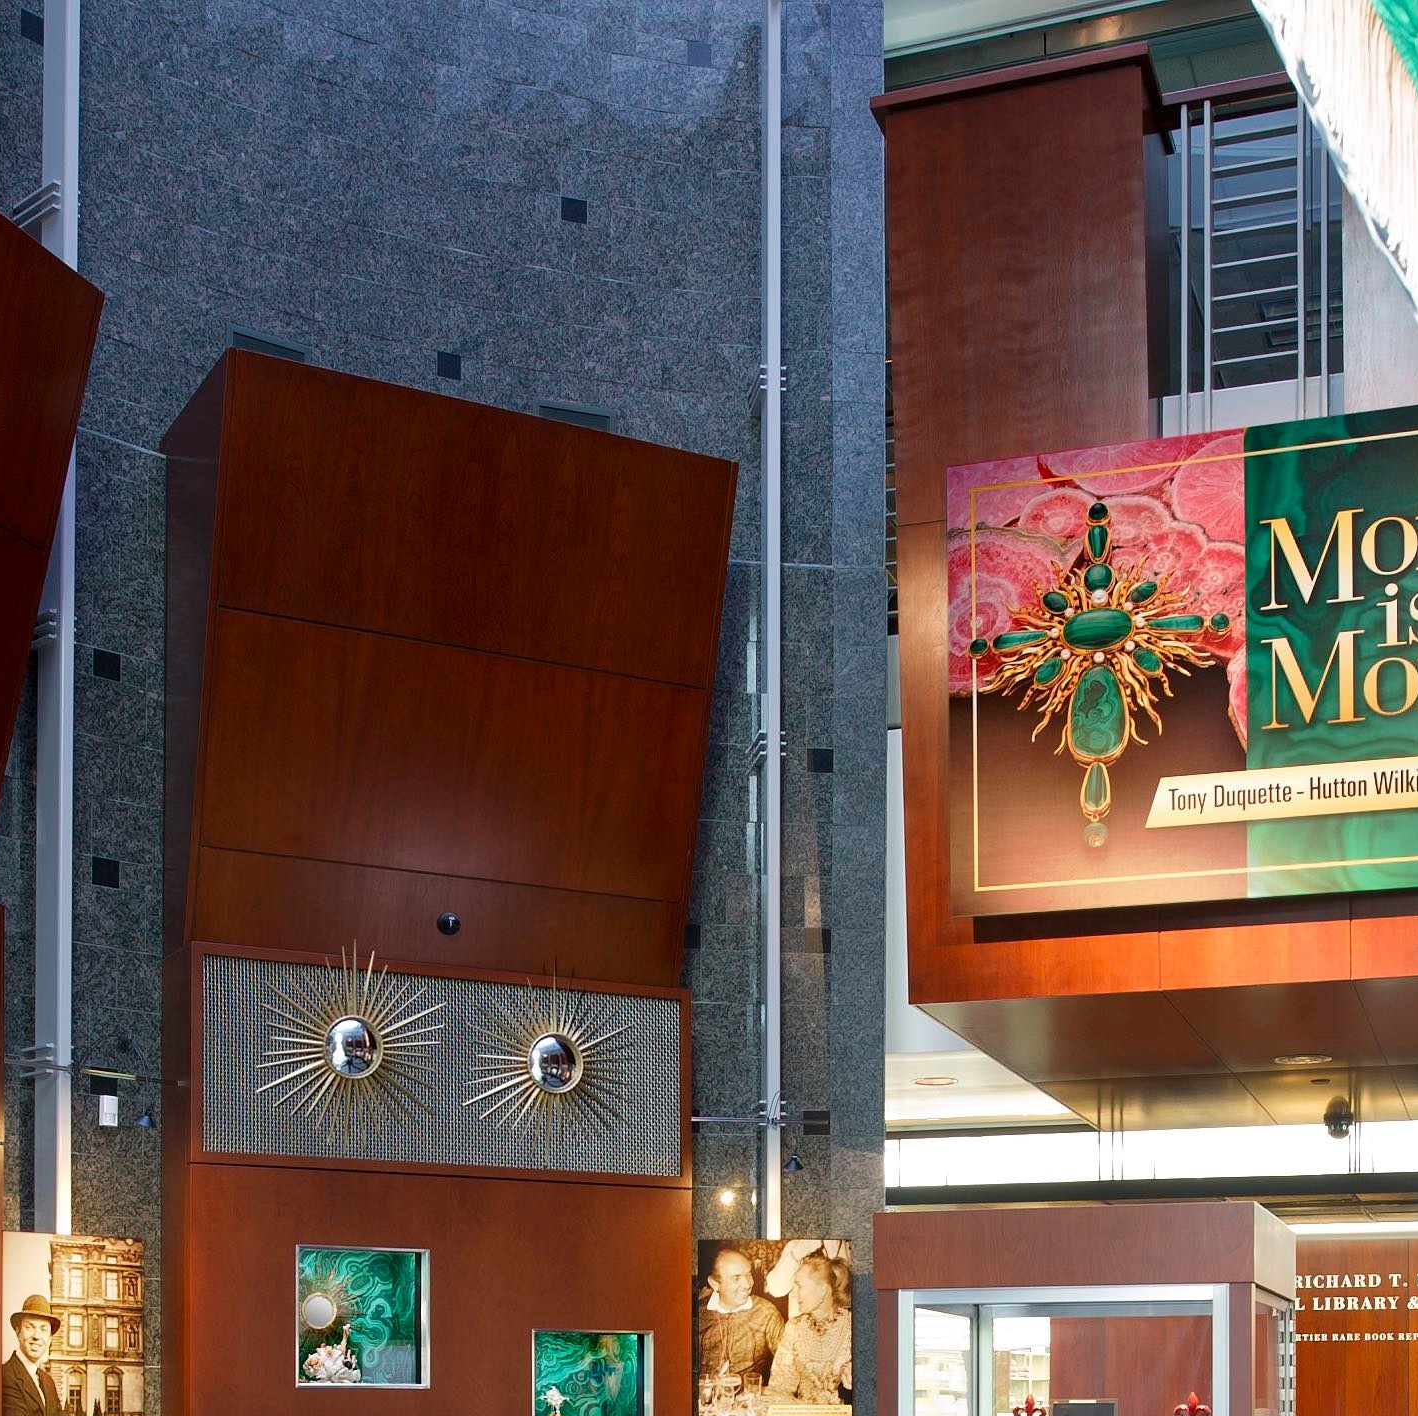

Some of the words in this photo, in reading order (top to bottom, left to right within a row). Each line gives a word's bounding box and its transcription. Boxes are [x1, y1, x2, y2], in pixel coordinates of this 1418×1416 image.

[1168, 788, 1207, 815] Tony
[1214, 783, 1292, 811] Duquette
[1309, 776, 1368, 801] Hutton
[1295, 1273, 1382, 1289] RICHARD
[1388, 1273, 1409, 1288] T.
[1312, 1296, 1401, 1311] LIBRARY
[1295, 1333, 1328, 1342] RTIER
[1332, 1333, 1361, 1341] RARE
[1364, 1333, 1395, 1341] BOOK
